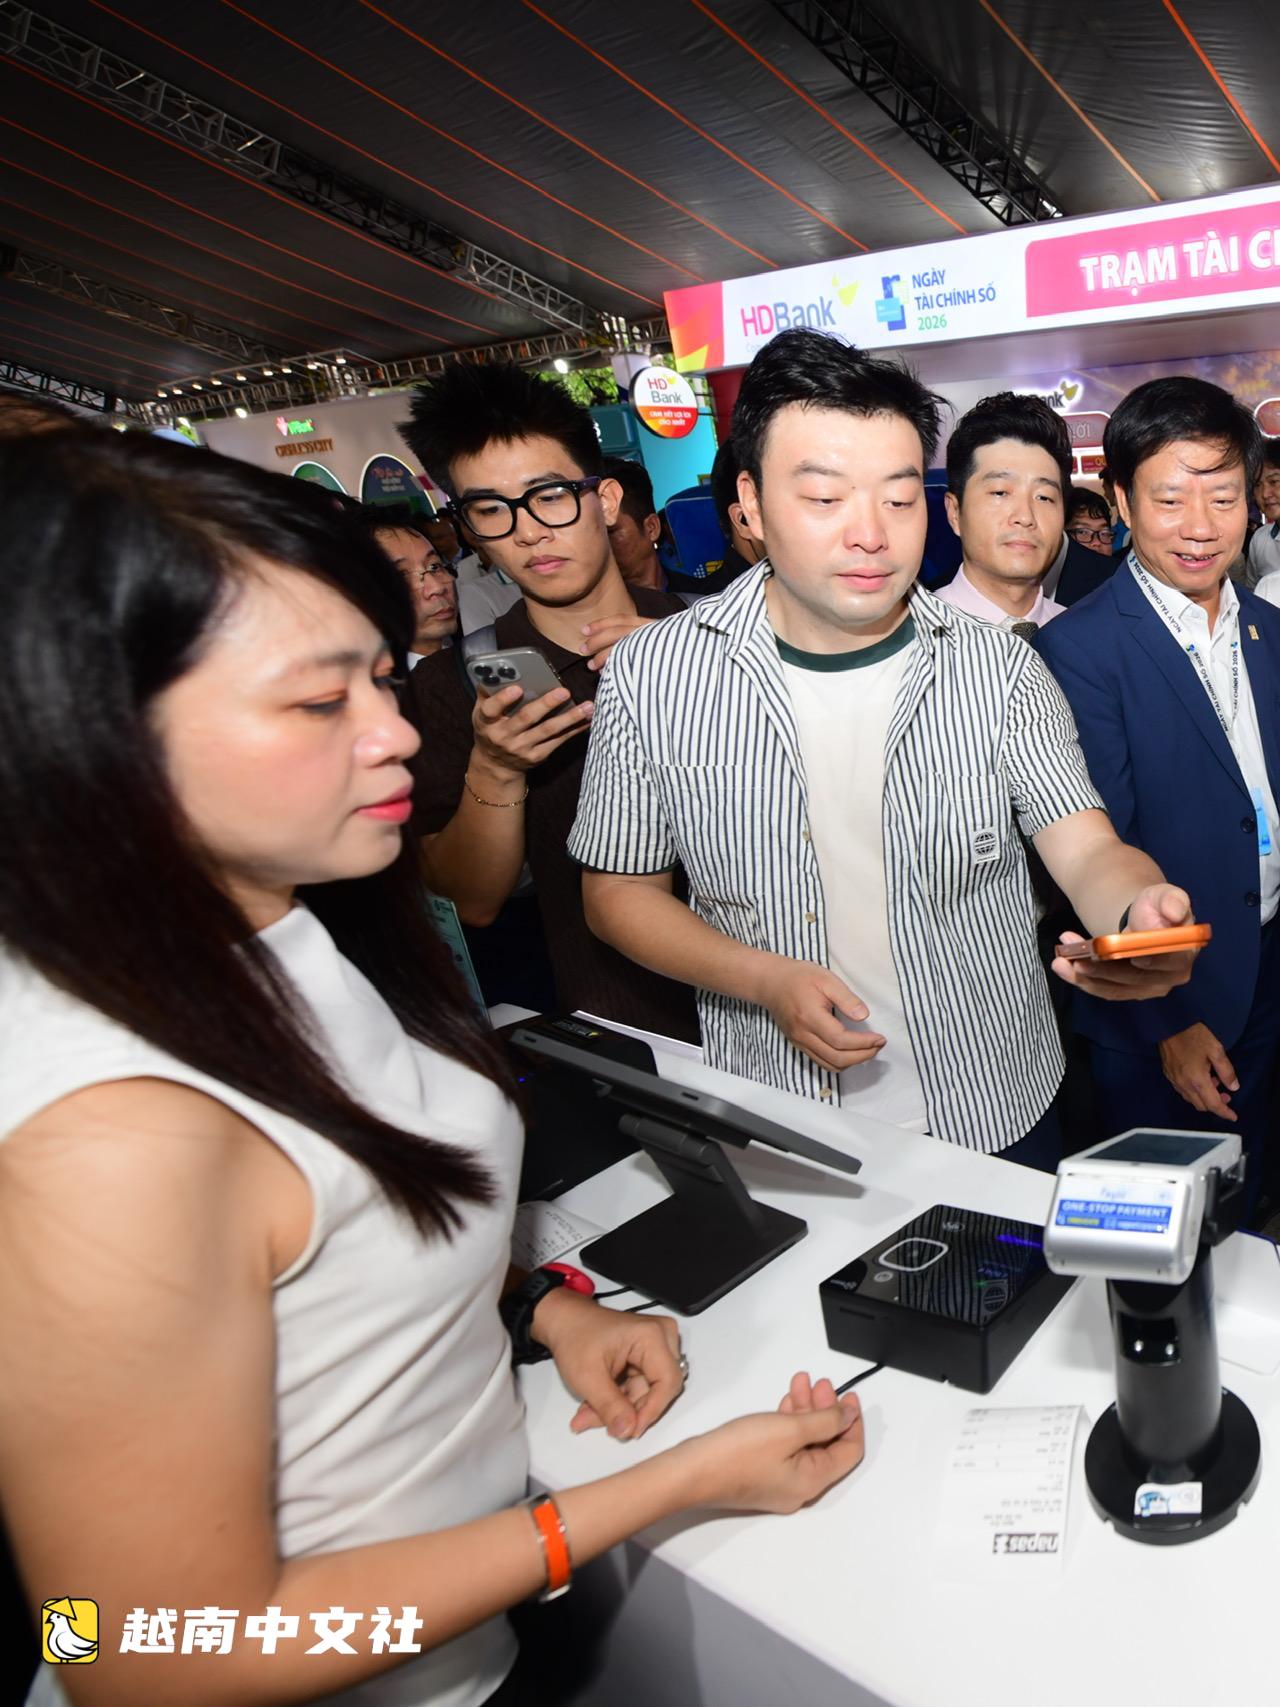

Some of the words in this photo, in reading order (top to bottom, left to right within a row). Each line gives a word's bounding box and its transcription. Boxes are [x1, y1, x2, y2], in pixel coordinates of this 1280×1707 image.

[1079, 245, 1178, 297] TRẠM
[1183, 231, 1239, 278] TÀI
[912, 270, 946, 289] NGÀY
[914, 294, 934, 311] TÀI
[936, 288, 976, 308] CHÍNH
[978, 281, 996, 303] SỐ
[740, 296, 836, 337] HDBank
[917, 314, 948, 331] 2026
[647, 378, 667, 390] HD
[651, 390, 683, 404] Bank
[1147, 584, 1163, 605] CHÍNH
[1193, 652, 1204, 668] 2026
[1062, 1201, 1116, 1215] ONE-STOP
[1117, 1205, 1169, 1218] PAYMENT
